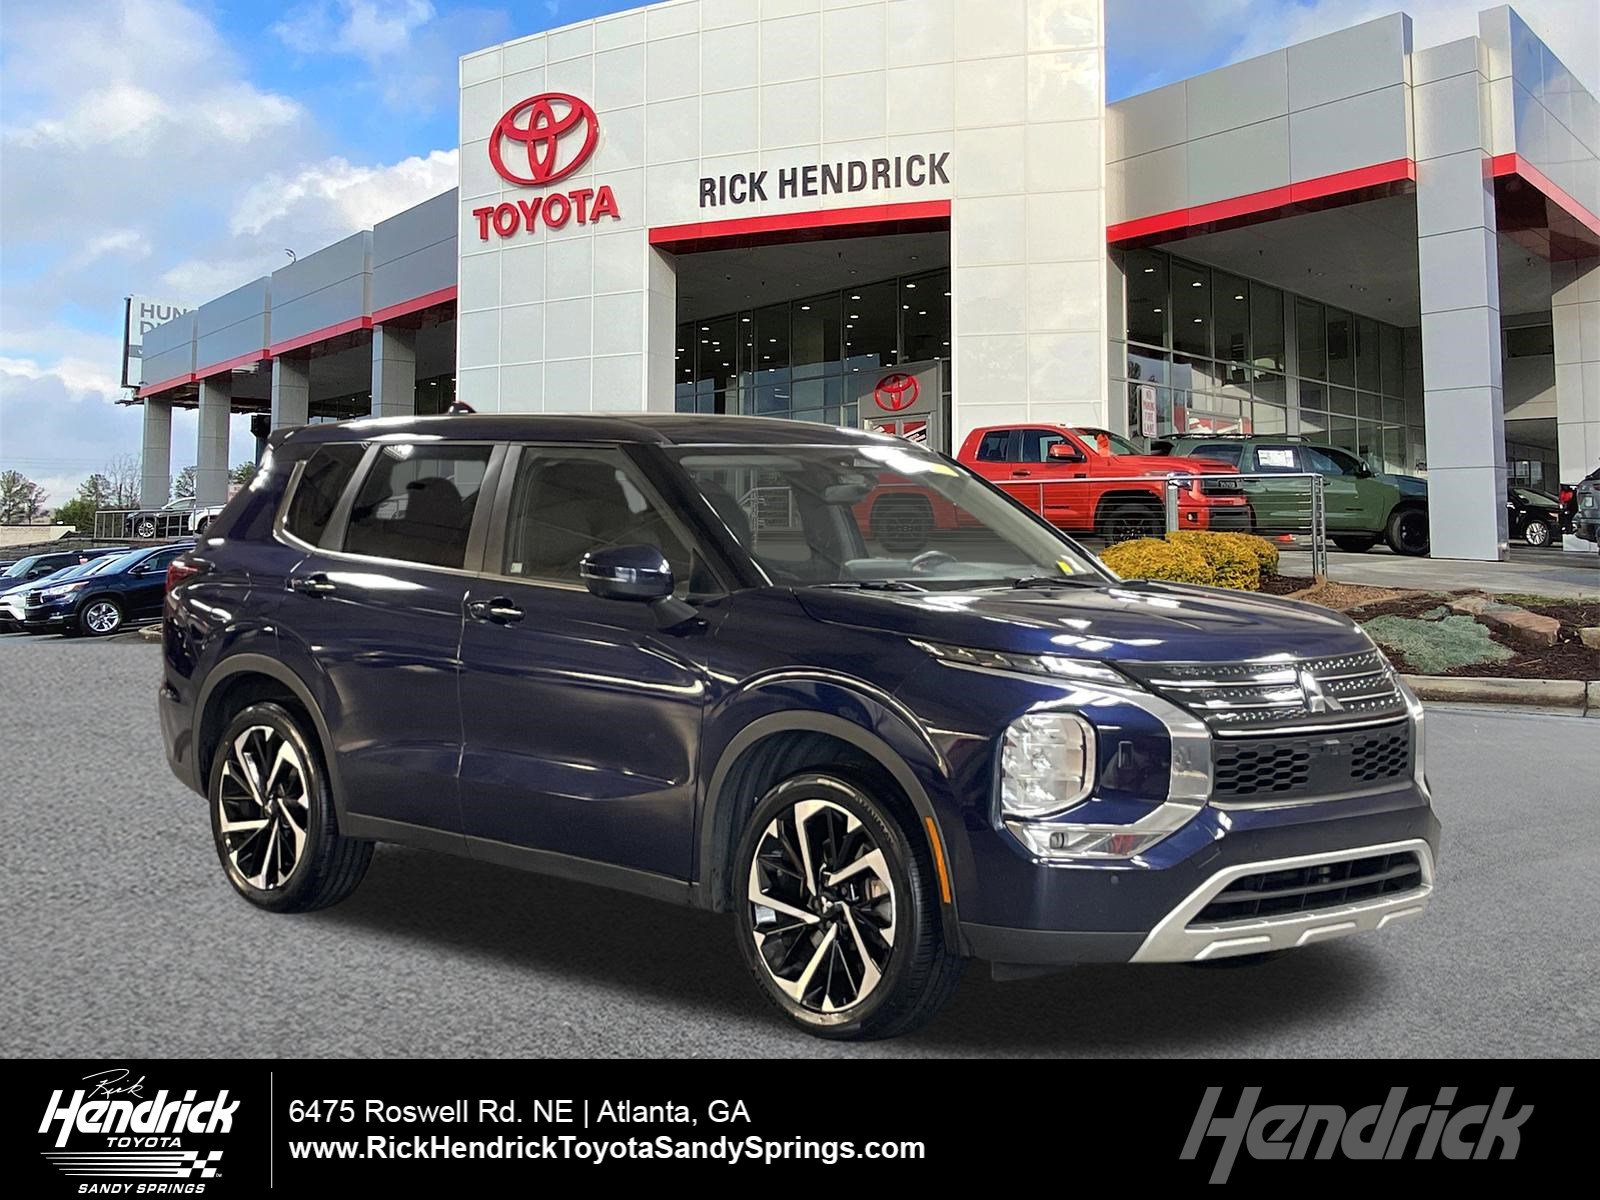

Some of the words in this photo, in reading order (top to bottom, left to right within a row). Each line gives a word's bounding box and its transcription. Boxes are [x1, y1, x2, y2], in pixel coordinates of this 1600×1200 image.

[699, 170, 768, 208] RICK
[778, 152, 950, 199] HENDRICK
[472, 185, 620, 240] TOYOTA
